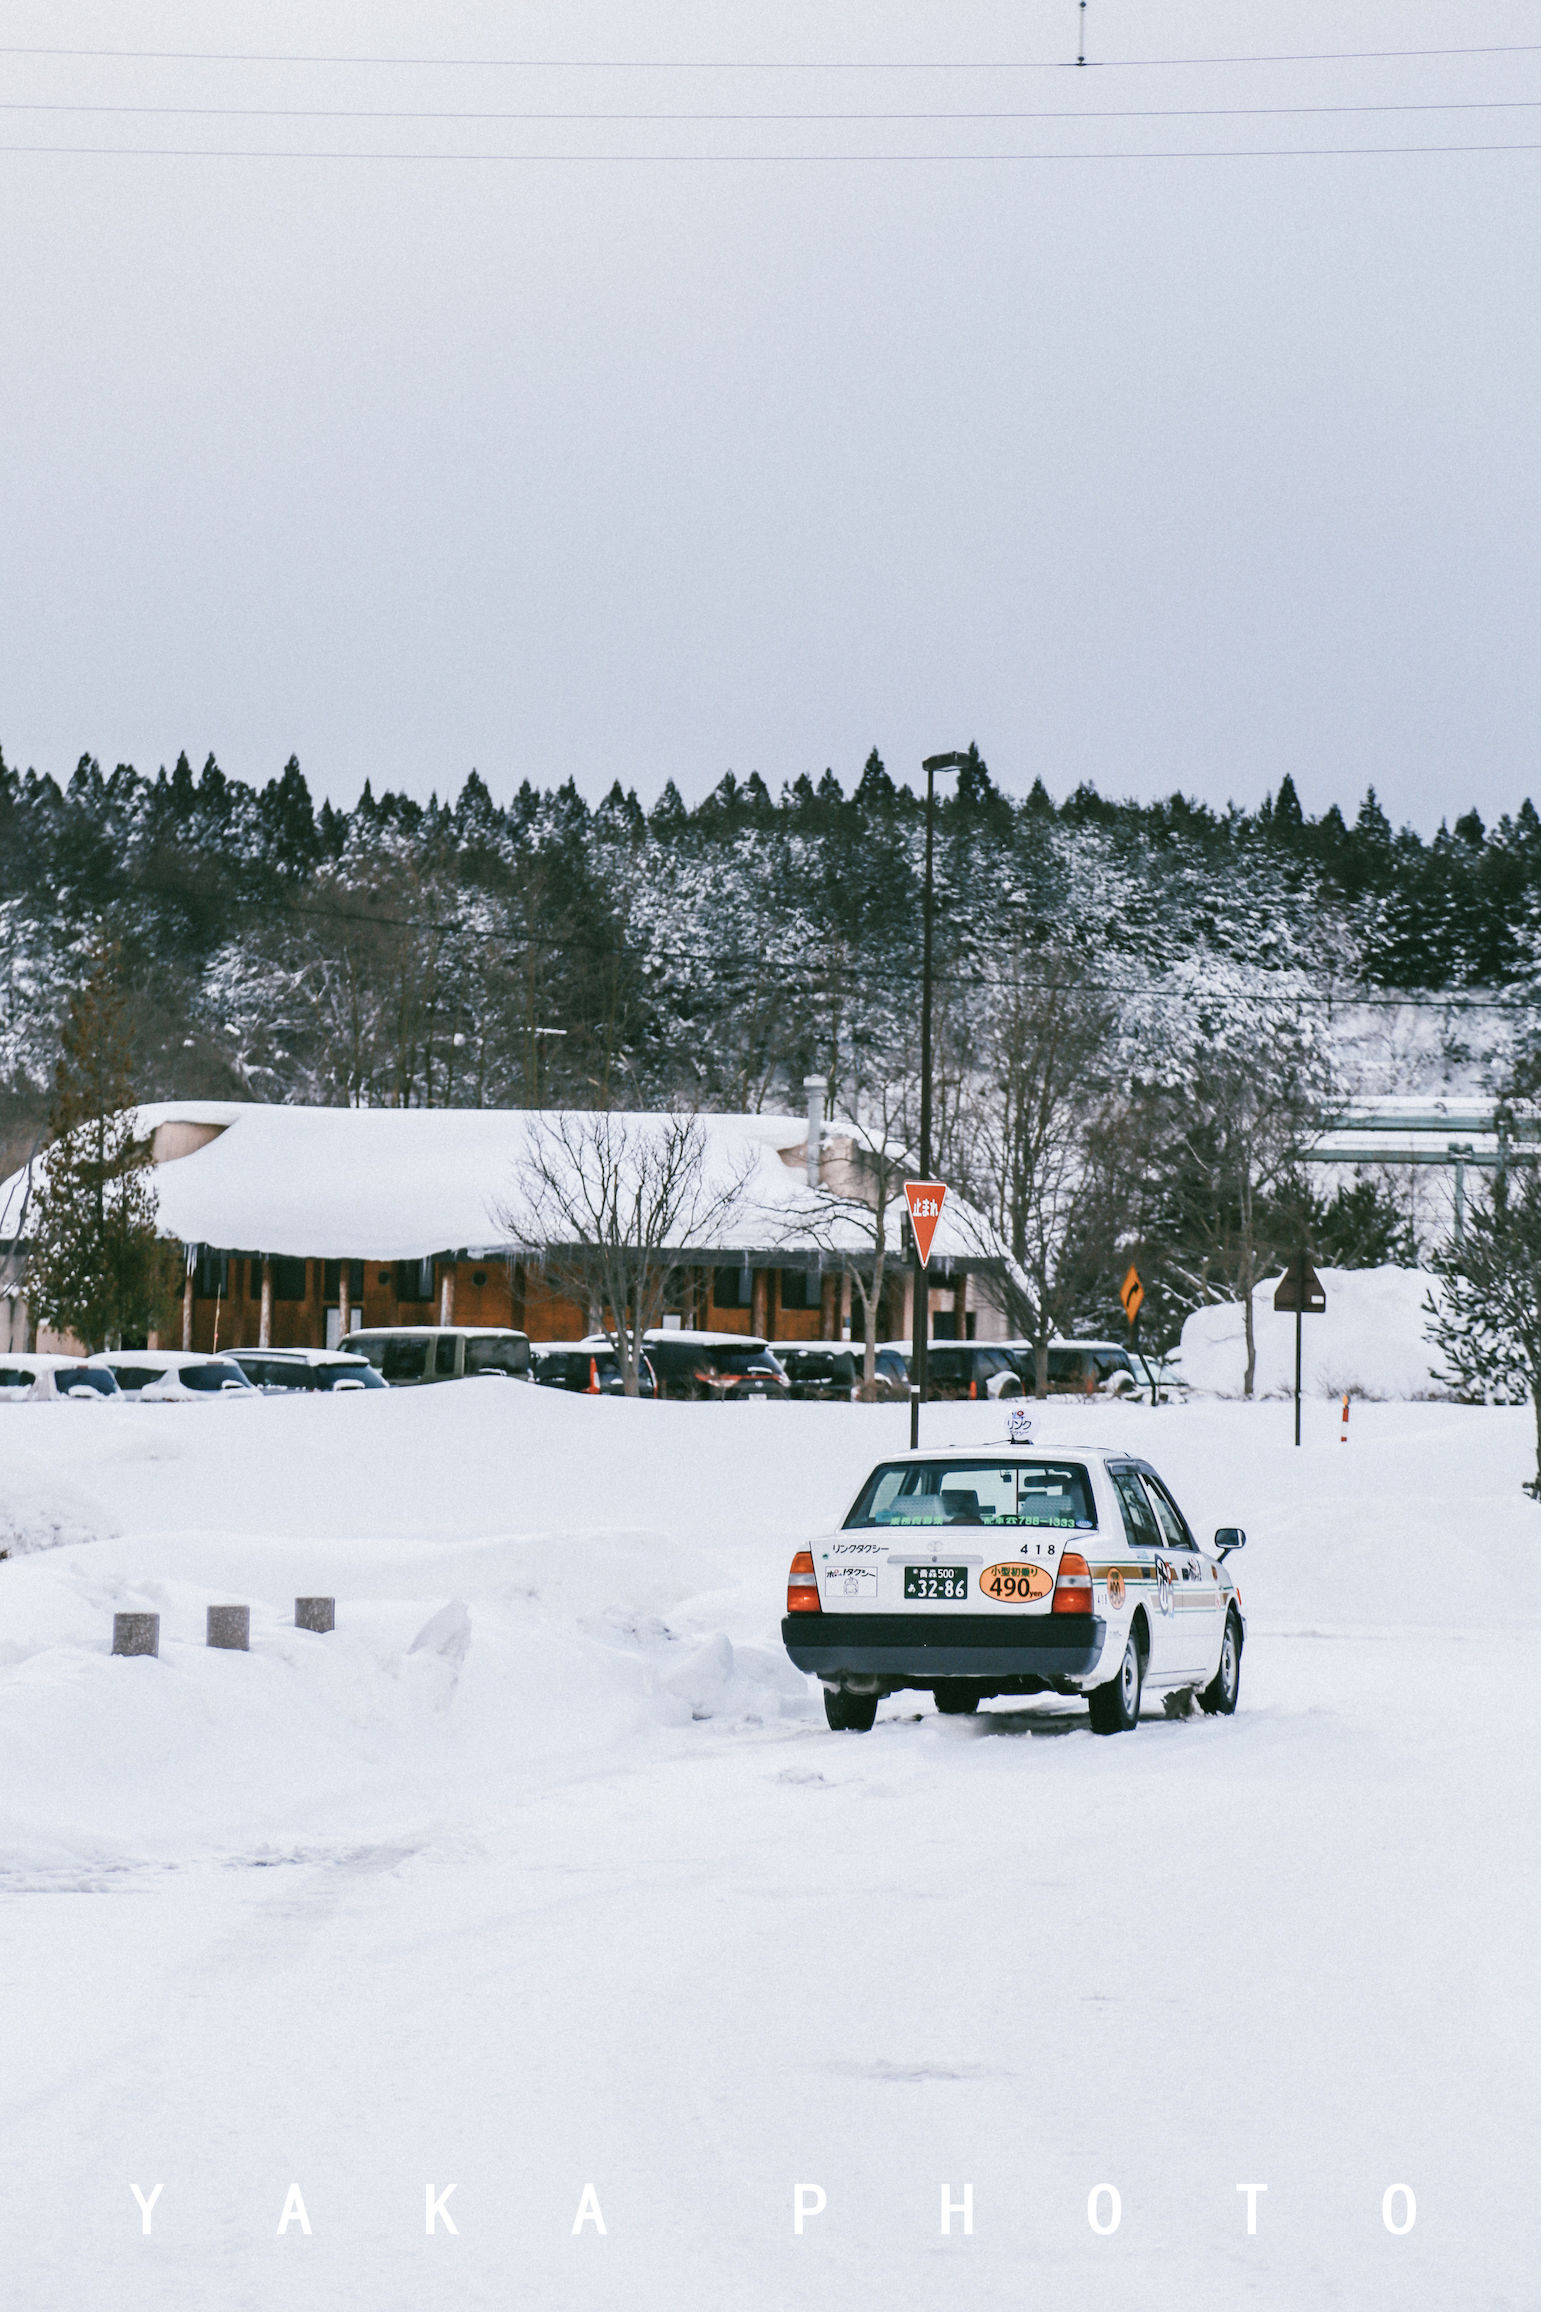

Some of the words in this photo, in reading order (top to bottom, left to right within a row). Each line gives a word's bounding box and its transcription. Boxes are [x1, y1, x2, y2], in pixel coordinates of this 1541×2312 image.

[913, 1198, 938, 1217] 止まれ
[832, 1544, 889, 1554] リンクタクシー
[991, 1565, 1038, 1577] 小型初乗り
[917, 1579, 965, 1598] 32-86
[989, 1577, 1030, 1597] 490
